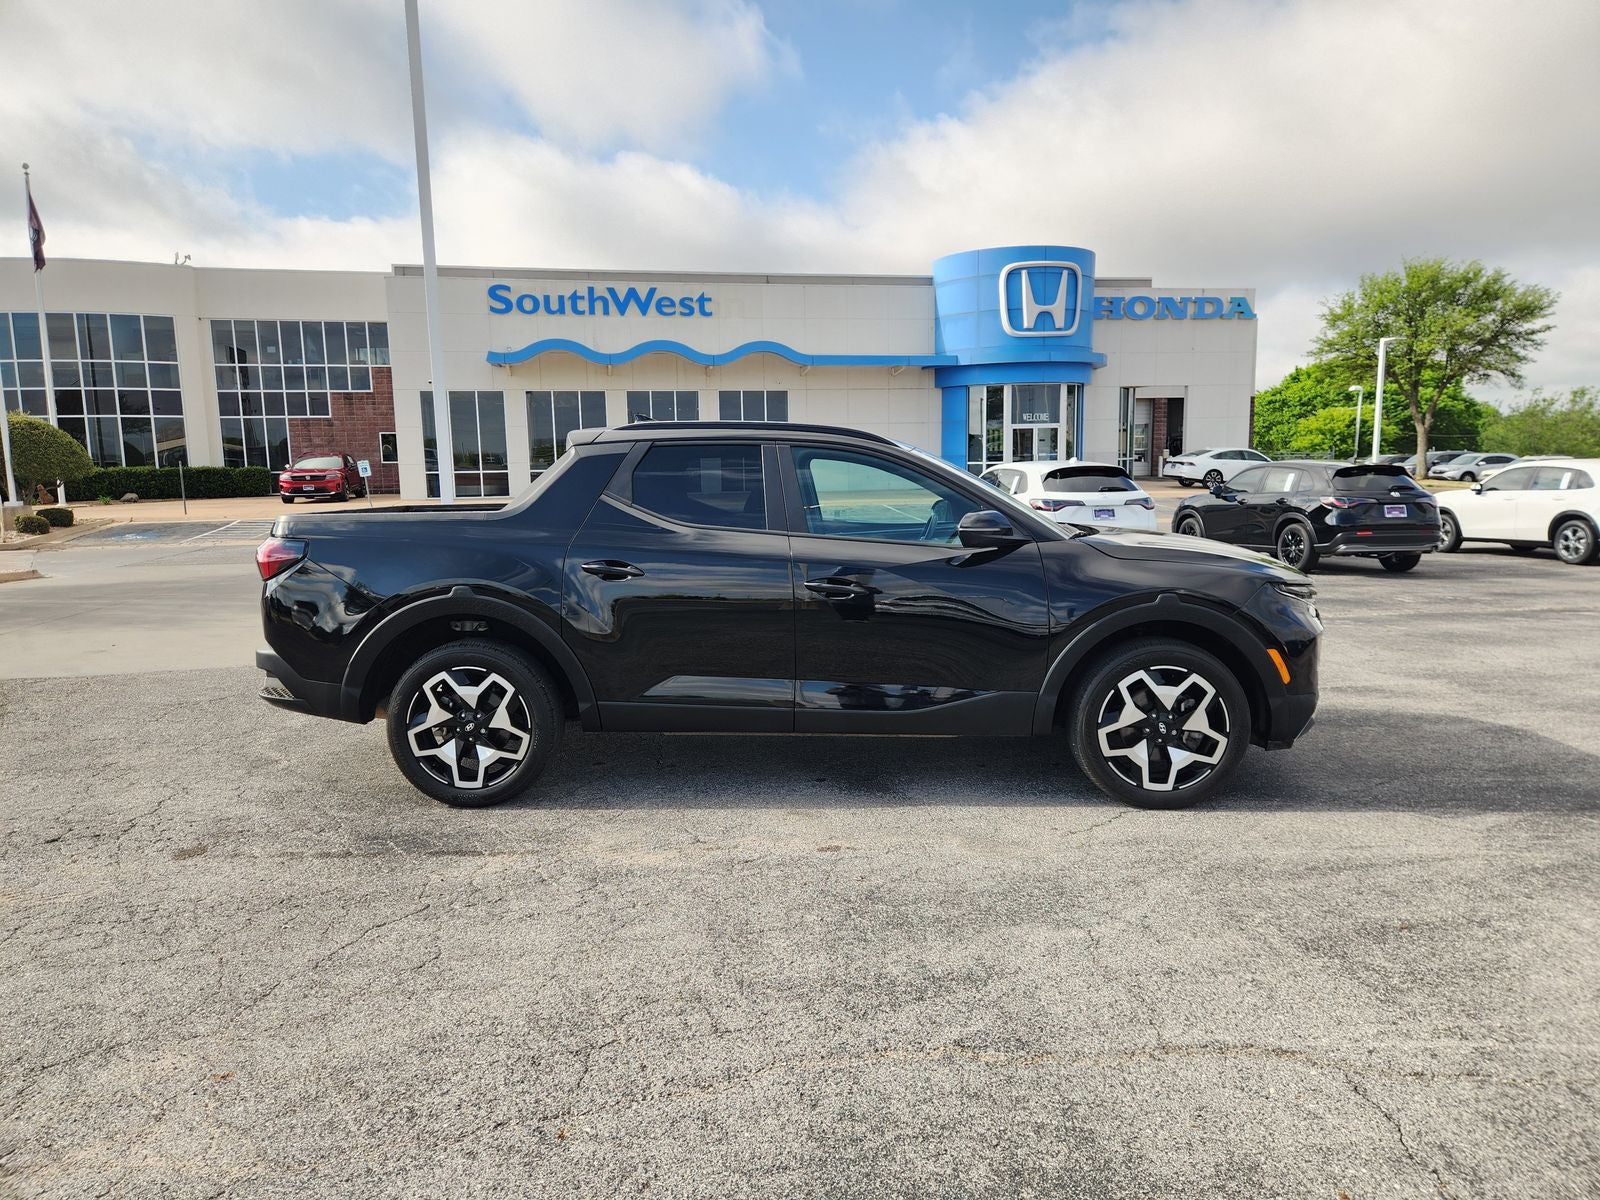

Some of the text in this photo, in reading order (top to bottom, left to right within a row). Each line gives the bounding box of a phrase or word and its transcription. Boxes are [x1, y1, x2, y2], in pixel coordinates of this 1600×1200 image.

[487, 284, 713, 317] SouthWest
[1093, 295, 1257, 320] HONDA
[1023, 412, 1050, 421] WELCOME
